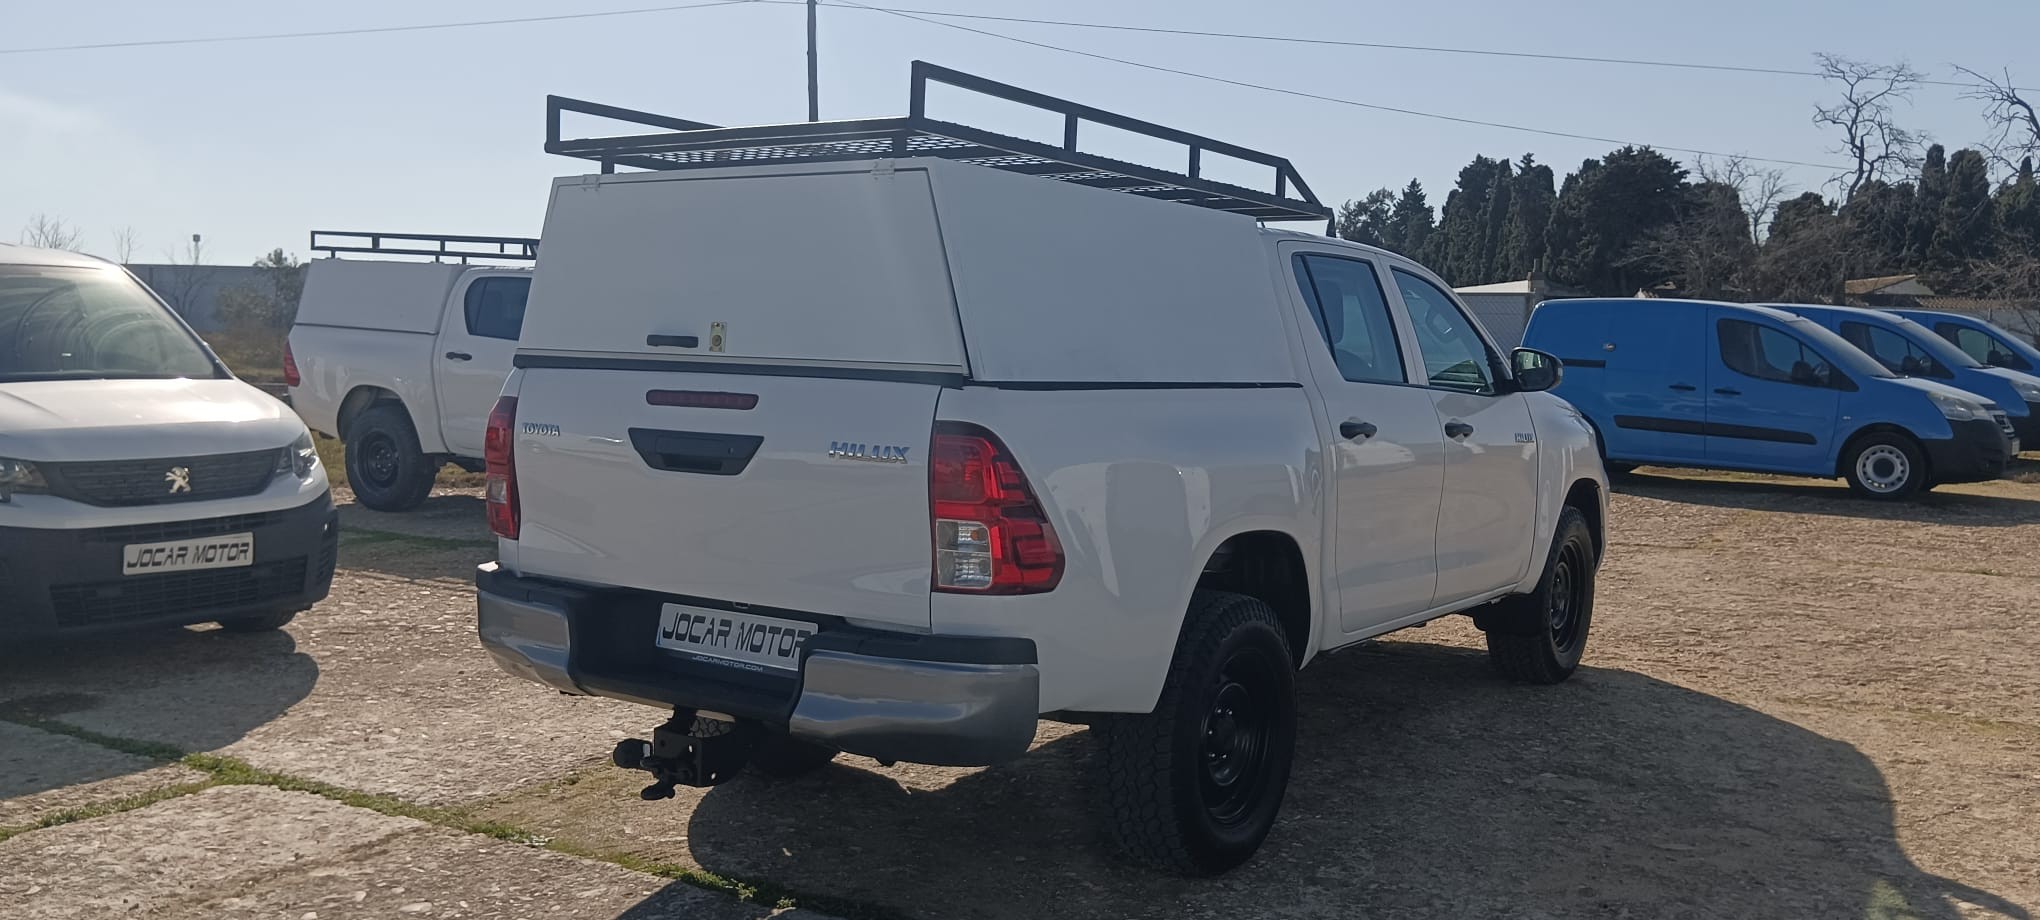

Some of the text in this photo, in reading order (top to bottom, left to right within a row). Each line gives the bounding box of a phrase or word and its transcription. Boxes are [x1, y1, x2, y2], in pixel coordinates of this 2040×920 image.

[522, 422, 560, 437] TOYOTA
[829, 441, 910, 463] HILUX
[127, 542, 250, 568] JOCAR MOTOR
[662, 612, 732, 649] JOCAR
[691, 655, 764, 673] JOCARMOTOR.COM
